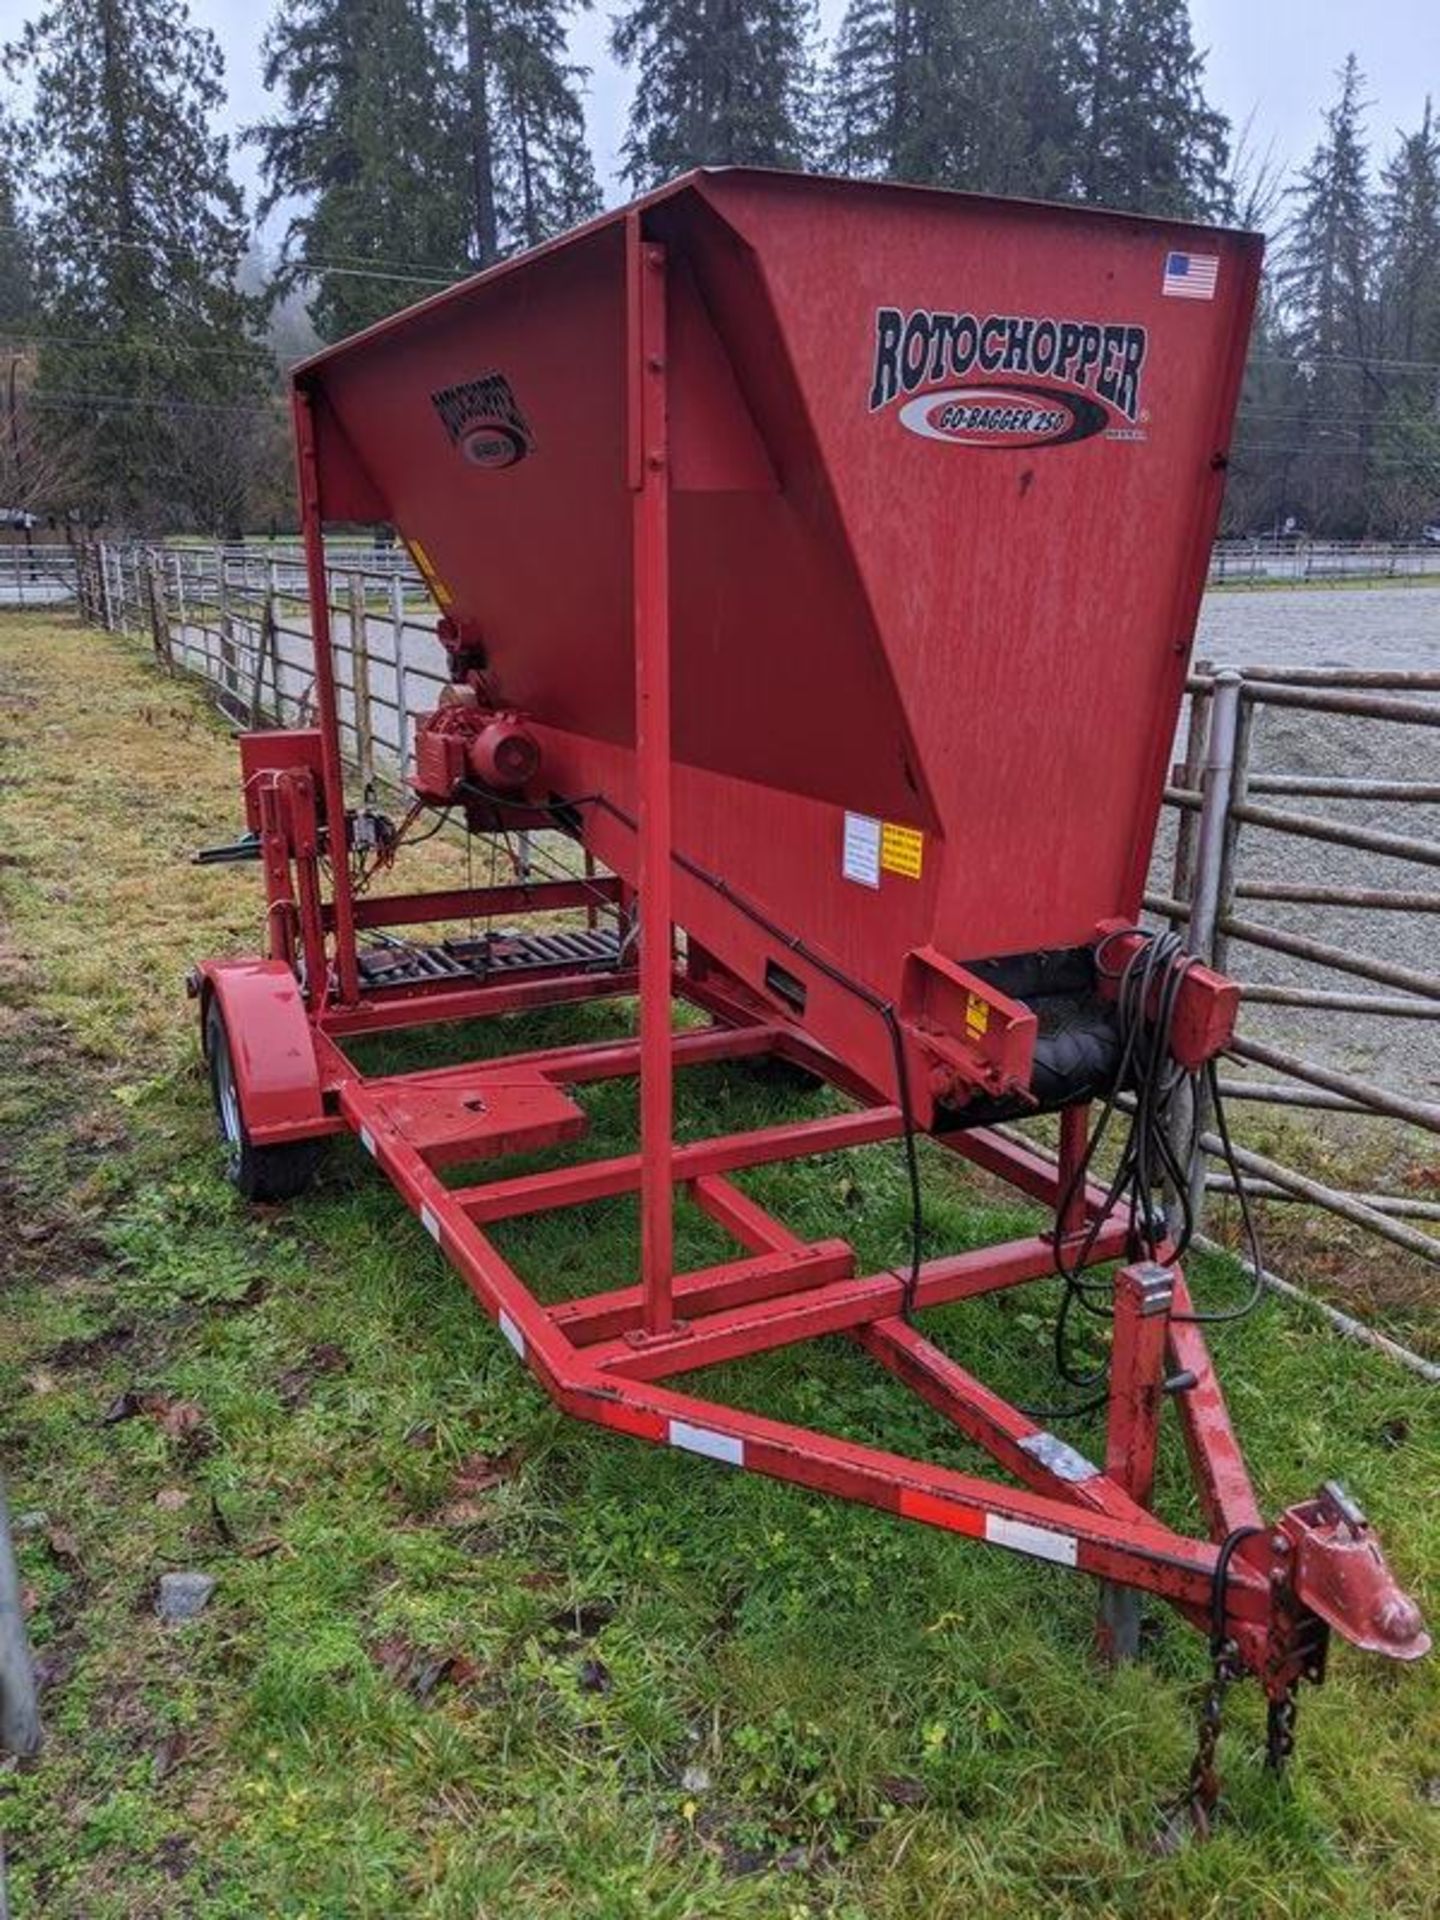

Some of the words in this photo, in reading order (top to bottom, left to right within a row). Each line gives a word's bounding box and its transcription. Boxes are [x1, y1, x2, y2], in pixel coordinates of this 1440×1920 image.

[870, 307, 1147, 424] ROTOCHOPPER
[939, 406, 1033, 430] GO-BAGGER
[1033, 410, 1065, 431] 250
